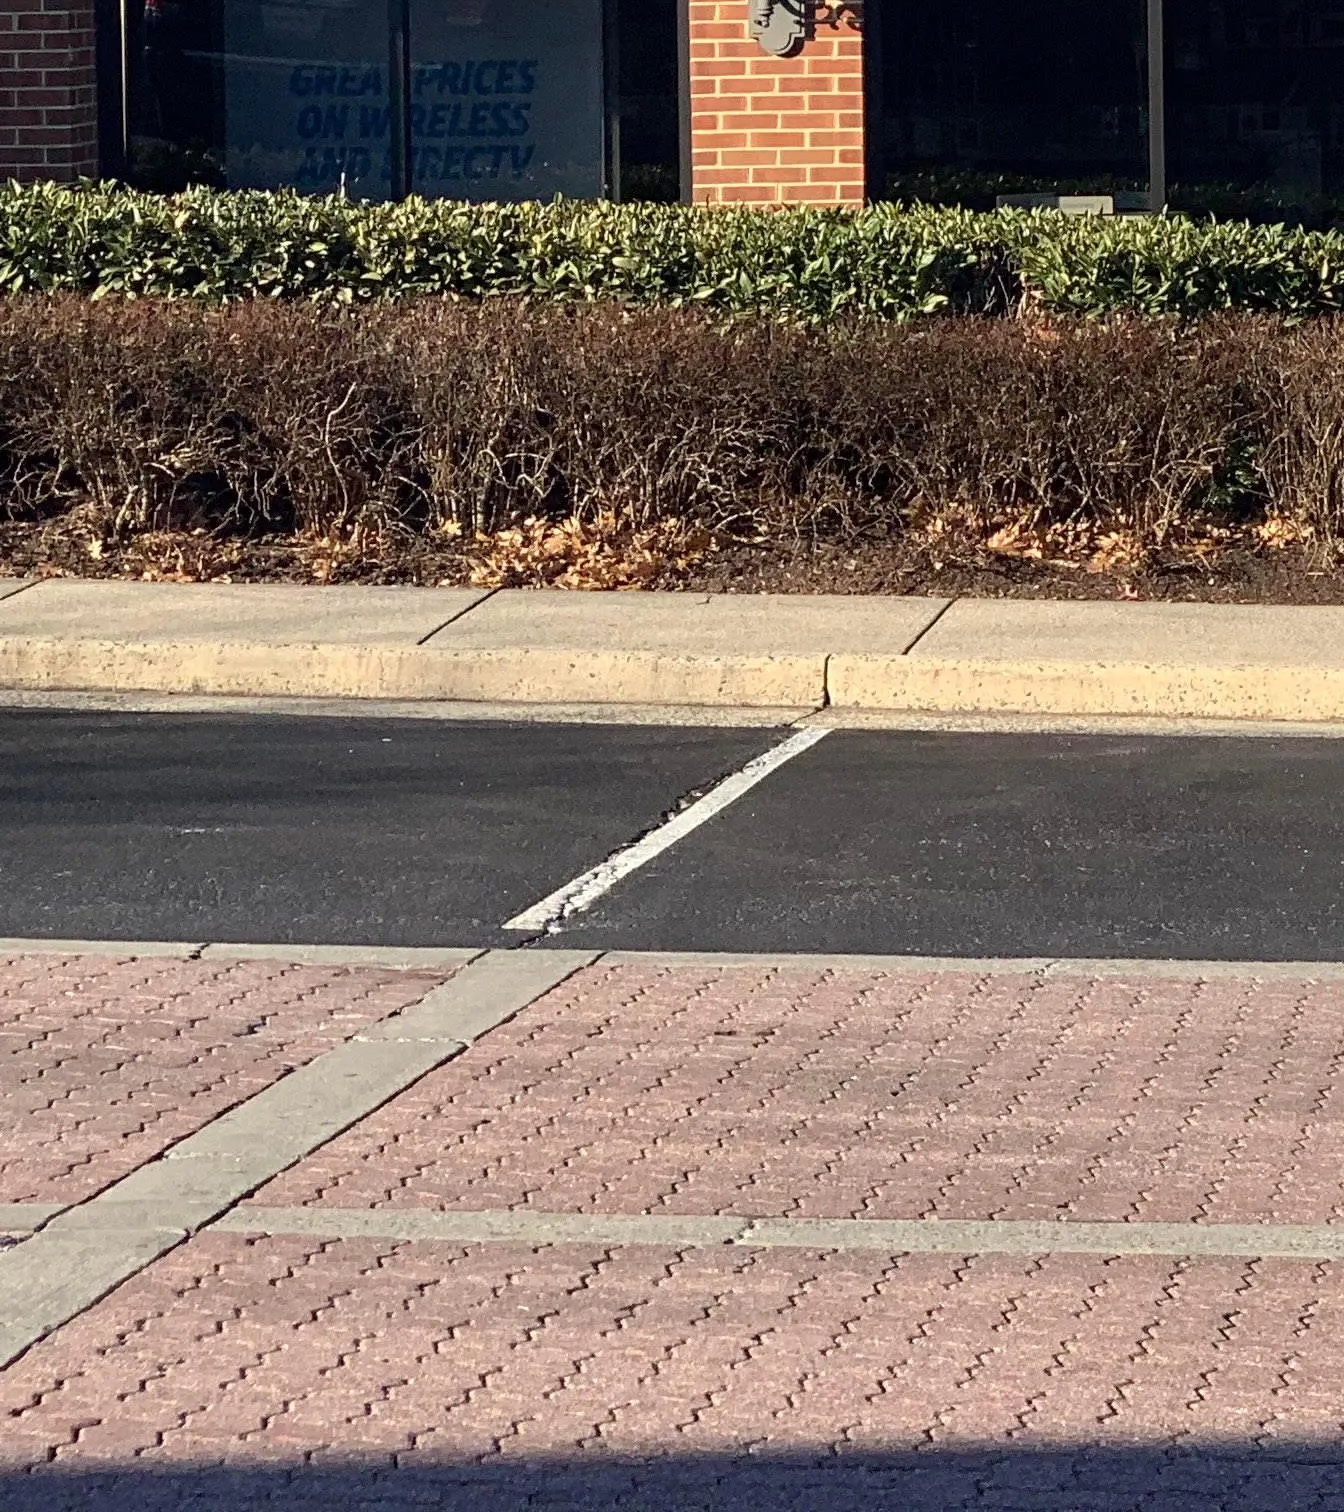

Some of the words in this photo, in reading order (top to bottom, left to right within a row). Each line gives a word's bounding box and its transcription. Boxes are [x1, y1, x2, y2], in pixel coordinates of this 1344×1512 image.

[412, 59, 539, 96] PRICES
[297, 104, 350, 139] ON
[359, 102, 533, 138] WRELESS
